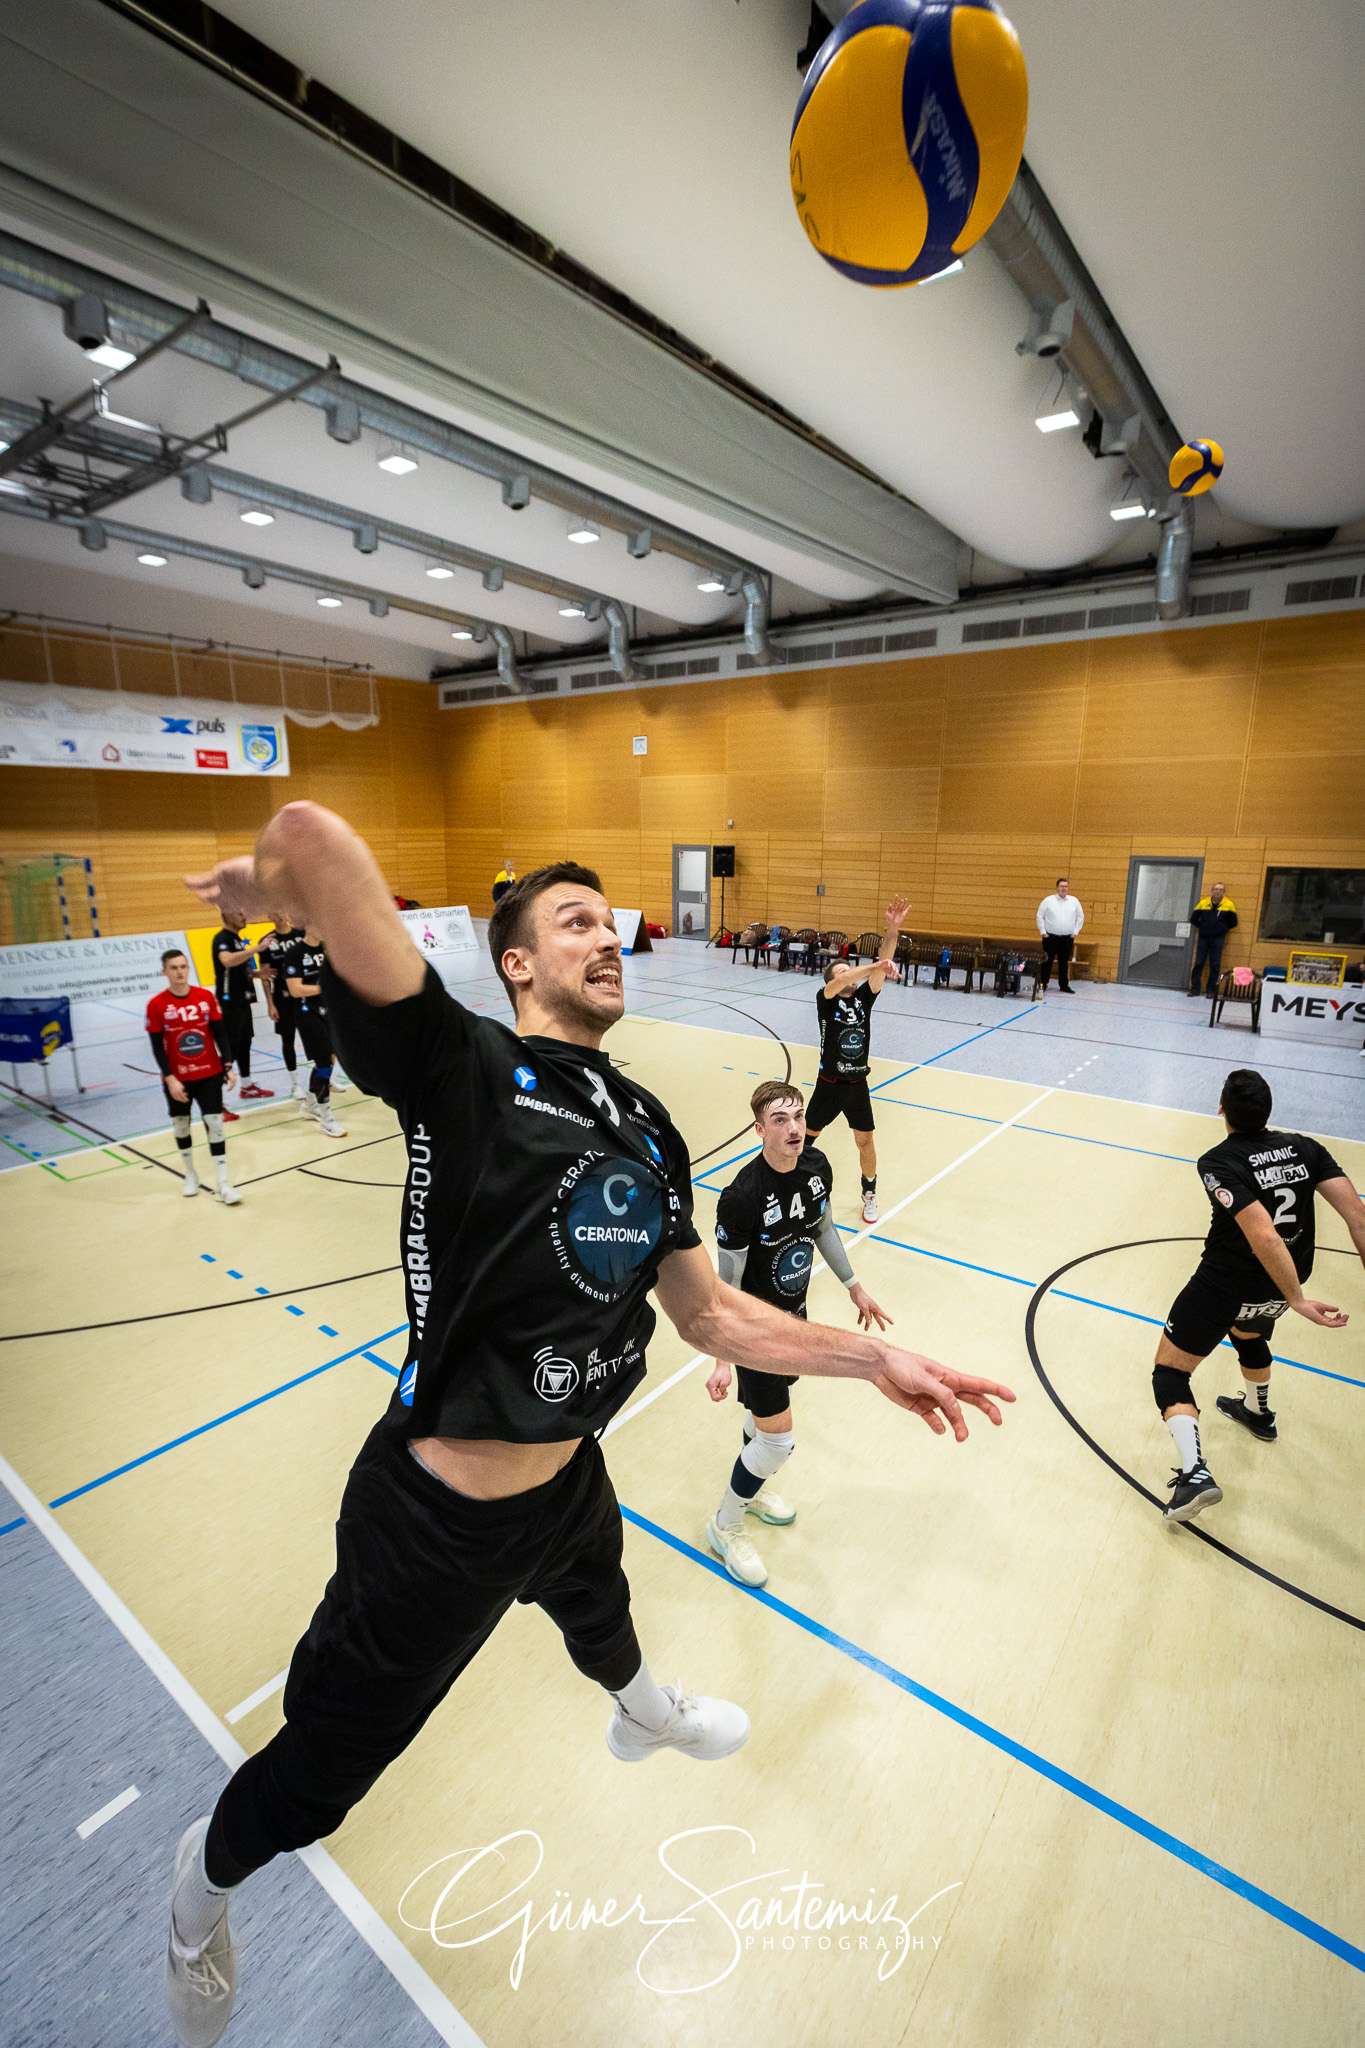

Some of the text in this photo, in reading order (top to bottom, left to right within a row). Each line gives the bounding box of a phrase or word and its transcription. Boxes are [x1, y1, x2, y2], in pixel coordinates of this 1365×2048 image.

[420, 910, 432, 919] die
[434, 907, 467, 918] Smarten
[83, 944, 96, 956] &
[102, 936, 177, 953] PARTNER
[177, 1005, 199, 1021] 12
[846, 1008, 857, 1022] 3
[514, 1094, 595, 1129] UMBRAGROUP
[1248, 1145, 1298, 1167] SIMUNIC
[789, 1192, 806, 1220] 4
[1273, 1187, 1297, 1226] 2
[574, 1225, 651, 1245] CERATONIA
[548, 1222, 610, 1303] quality diamond
[771, 1239, 798, 1270] CERATONIA
